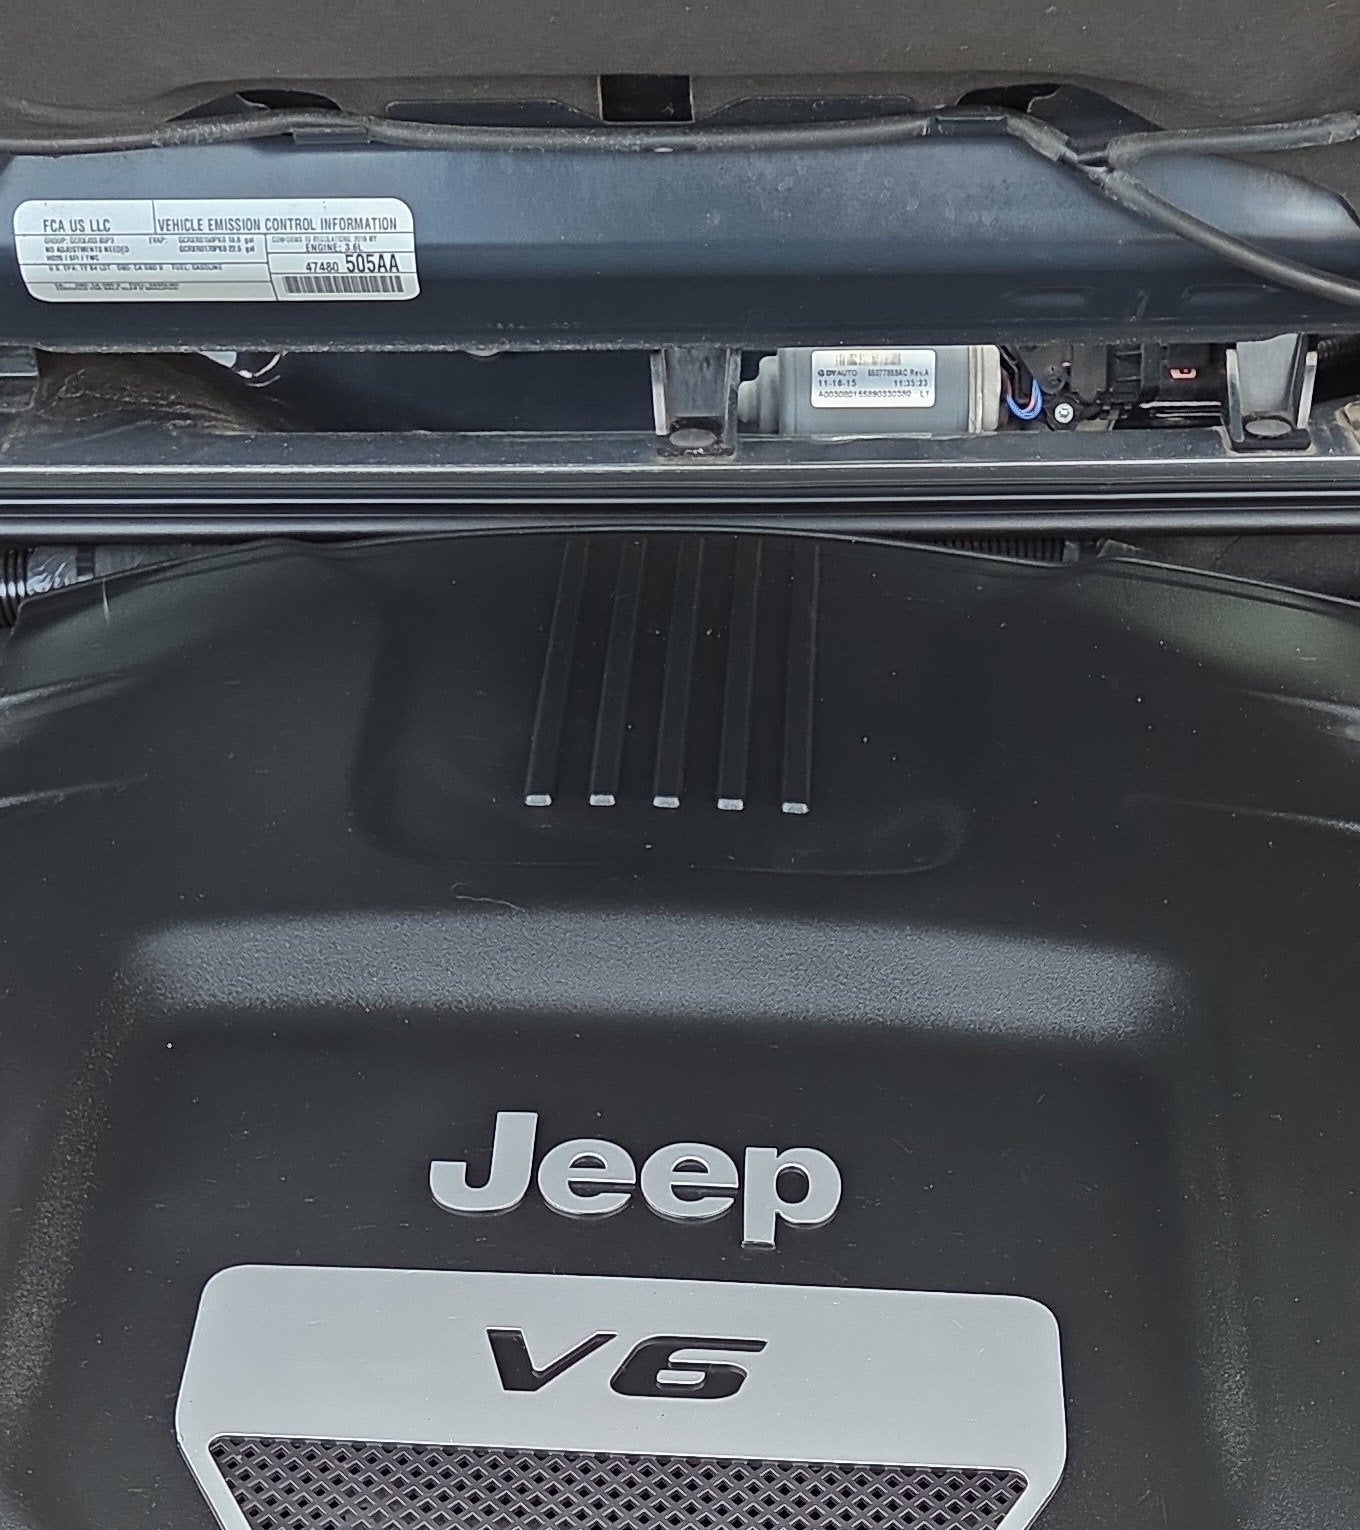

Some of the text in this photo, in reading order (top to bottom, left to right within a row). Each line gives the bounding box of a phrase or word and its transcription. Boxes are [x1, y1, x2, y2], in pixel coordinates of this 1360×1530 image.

[43, 218, 111, 233] FCA US LLC
[158, 216, 397, 232] VEHICLE EMISSION CONTROL INFORMATION
[345, 253, 400, 273] 505AA
[429, 1110, 842, 1249] Jeep
[484, 1327, 769, 1400] V6
